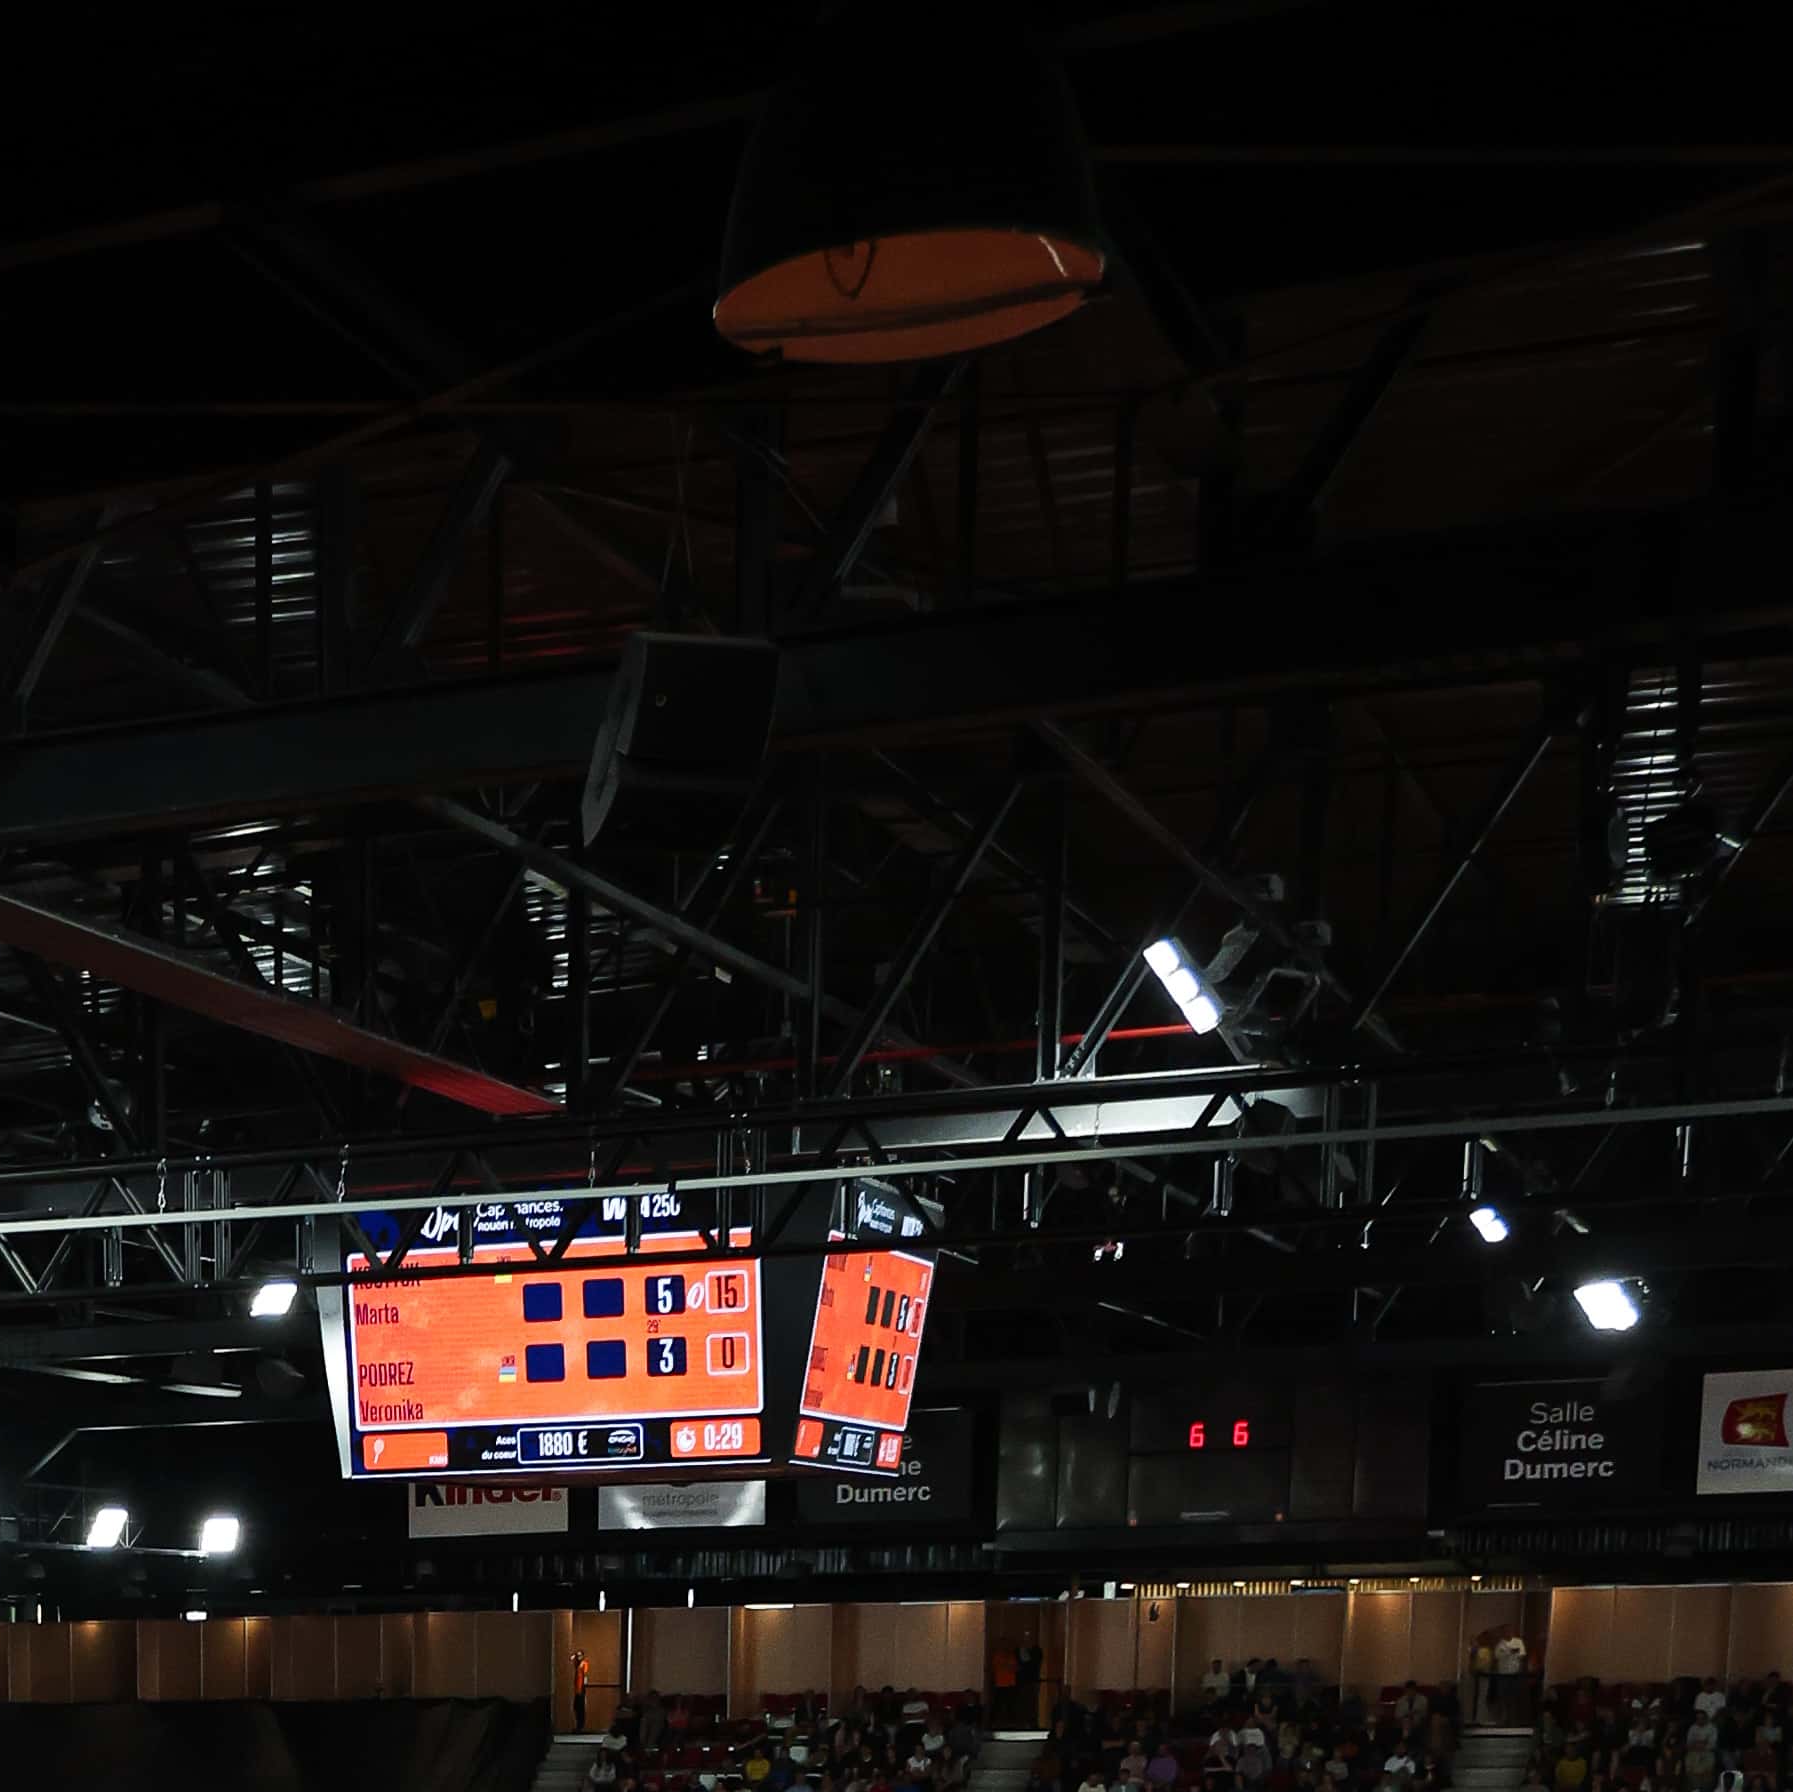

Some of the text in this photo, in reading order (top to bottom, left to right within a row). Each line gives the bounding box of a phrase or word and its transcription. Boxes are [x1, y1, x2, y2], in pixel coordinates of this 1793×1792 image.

[657, 1275, 738, 1314] 5 15
[355, 1303, 399, 1327] Marta
[659, 1336, 735, 1373] 3 0
[359, 1361, 415, 1388] PODREZ
[360, 1399, 424, 1422] Veronika
[1530, 1401, 1595, 1424] Salle
[538, 1431, 572, 1457] 1880
[578, 1430, 589, 1456] €
[704, 1423, 743, 1450] 0:29
[1189, 1420, 1249, 1448] 6 6
[1516, 1429, 1605, 1452] Céline
[1504, 1457, 1616, 1480] Dumerc
[836, 1482, 931, 1504] Dumerc
